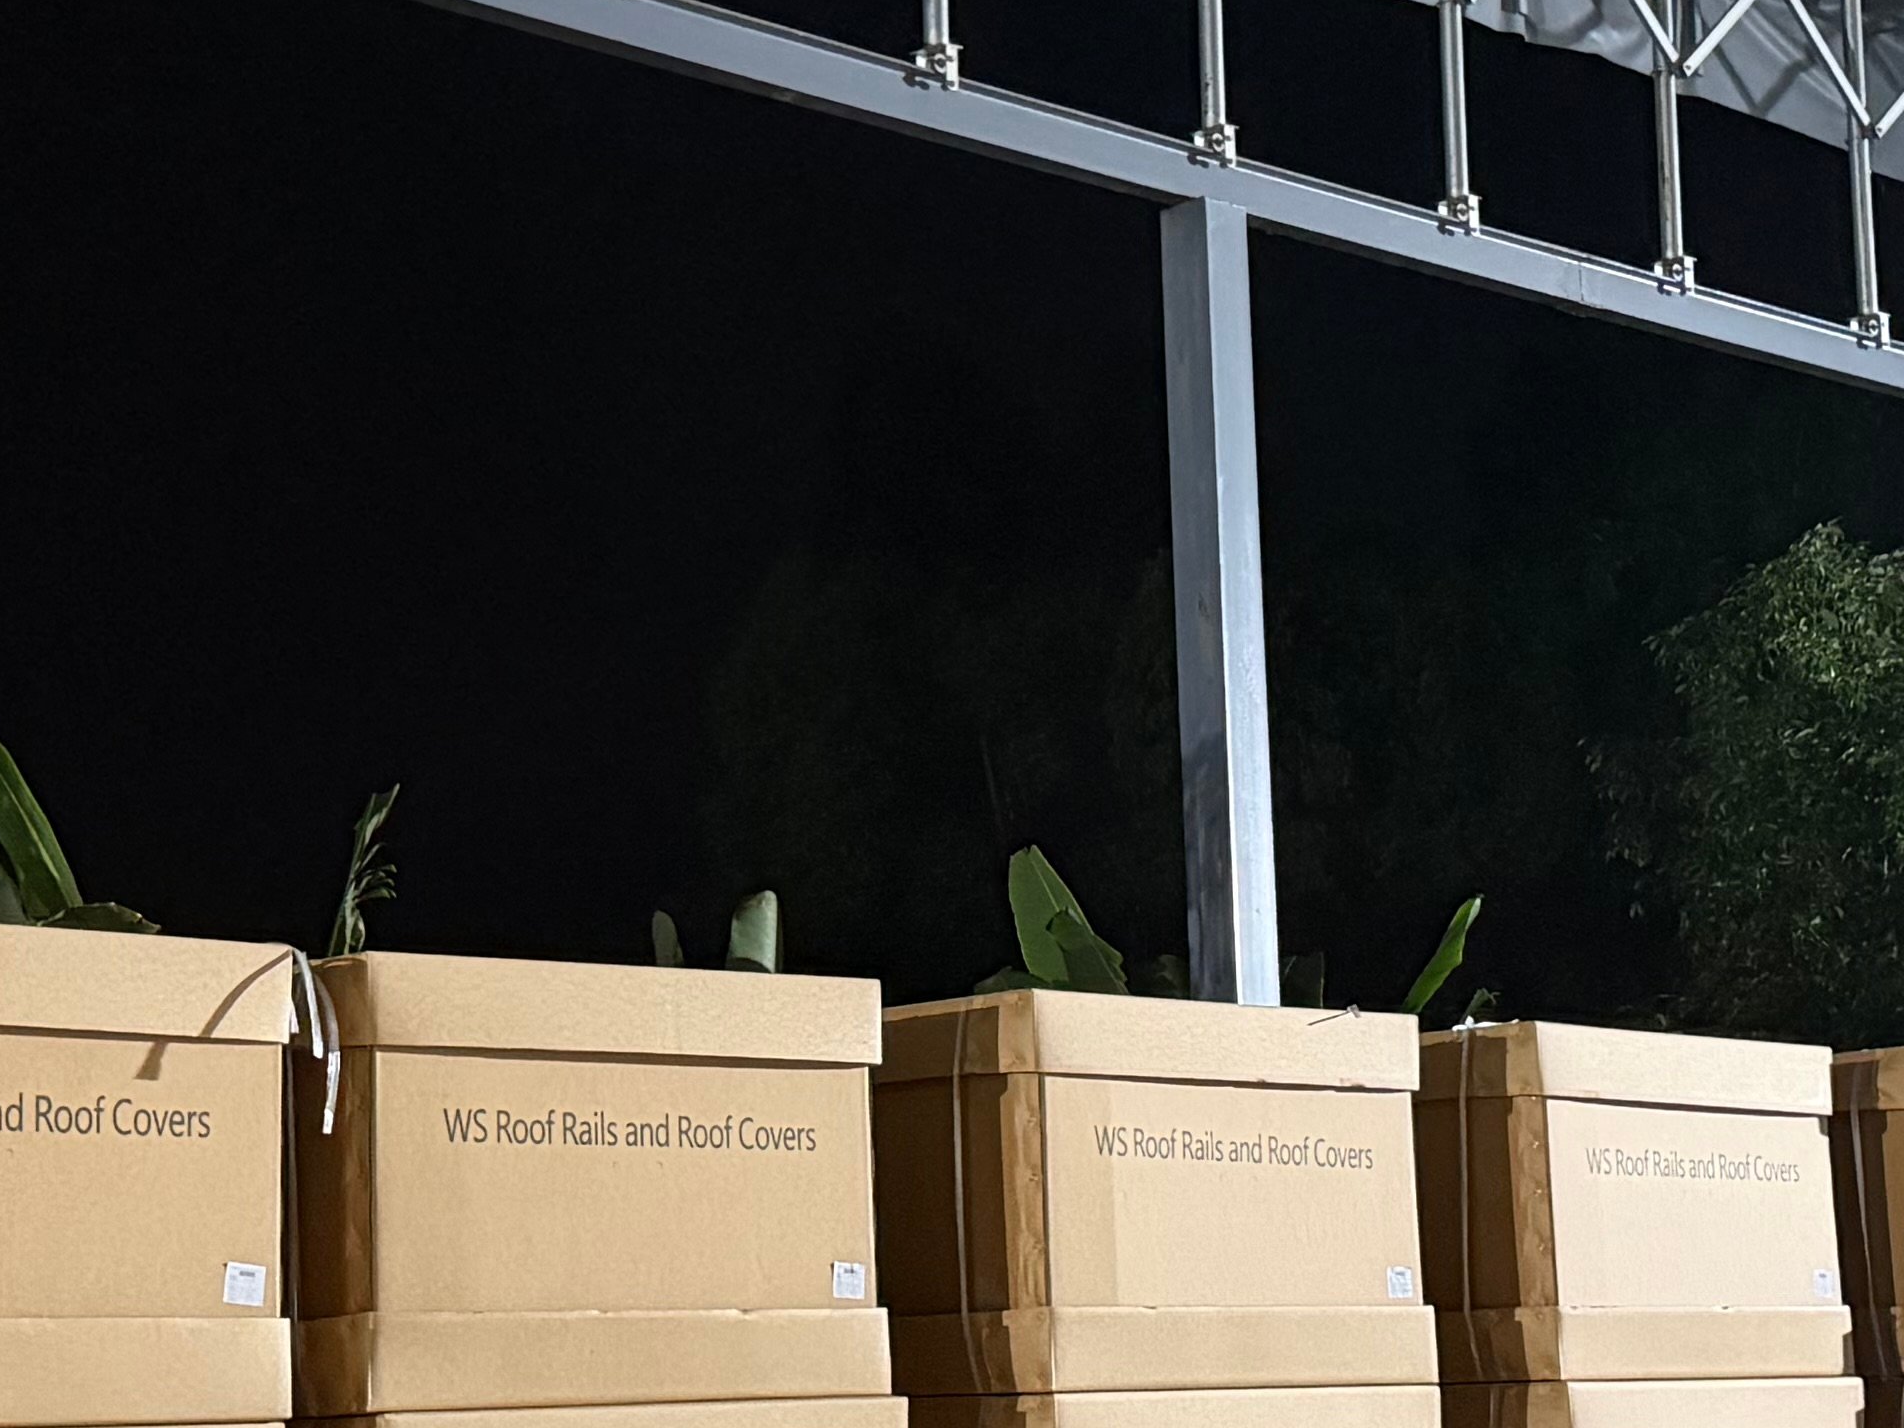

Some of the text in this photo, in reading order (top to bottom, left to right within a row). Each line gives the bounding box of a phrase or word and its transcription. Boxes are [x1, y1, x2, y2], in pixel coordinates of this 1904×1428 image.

[35, 1095, 106, 1134] Roof
[113, 1098, 210, 1138] Covers
[443, 1108, 816, 1151] WS Roof Rails and Roof Covers
[1094, 1125, 1373, 1169] WS Roof Rails and Roof Covers
[1586, 1148, 1800, 1182] WS Roof Rails and Roof Covers
